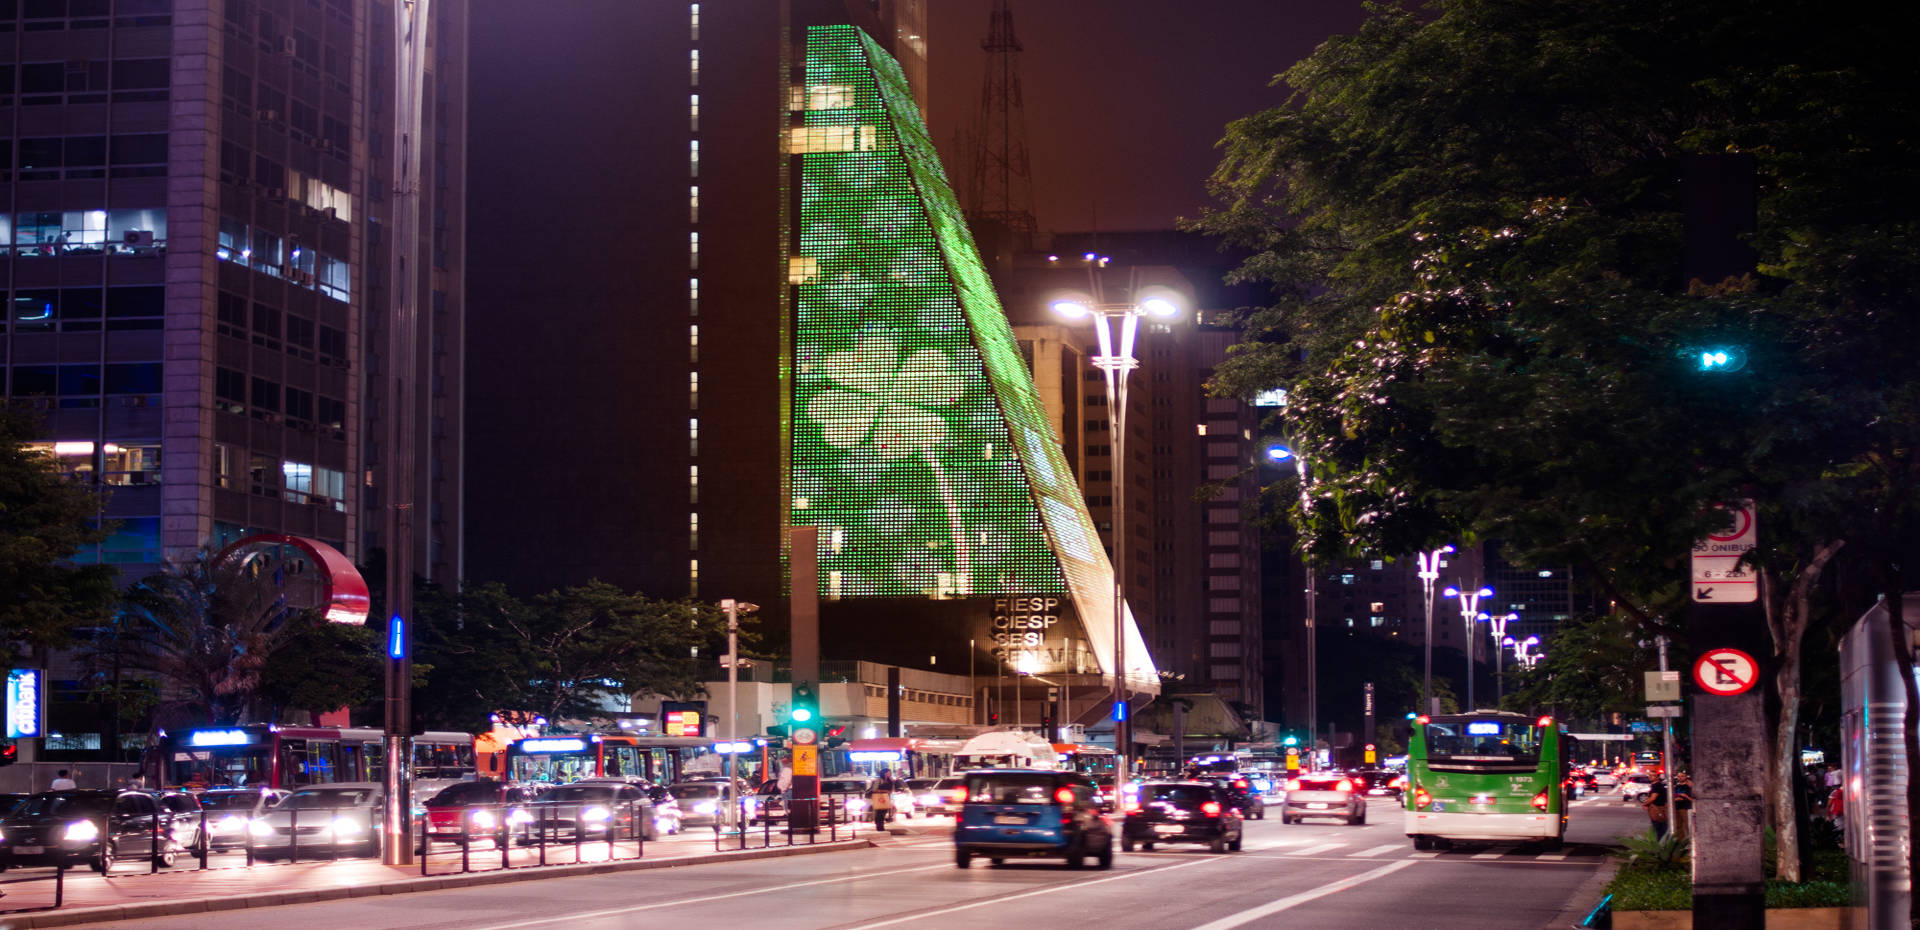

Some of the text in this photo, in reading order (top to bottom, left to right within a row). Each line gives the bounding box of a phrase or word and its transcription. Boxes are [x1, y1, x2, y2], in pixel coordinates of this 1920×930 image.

[1704, 570, 1711, 578] 6
[994, 598, 1058, 611] FIESP
[994, 615, 1058, 629] CIESP
[995, 632, 1044, 647] SESI
[16, 672, 36, 735] citibank
